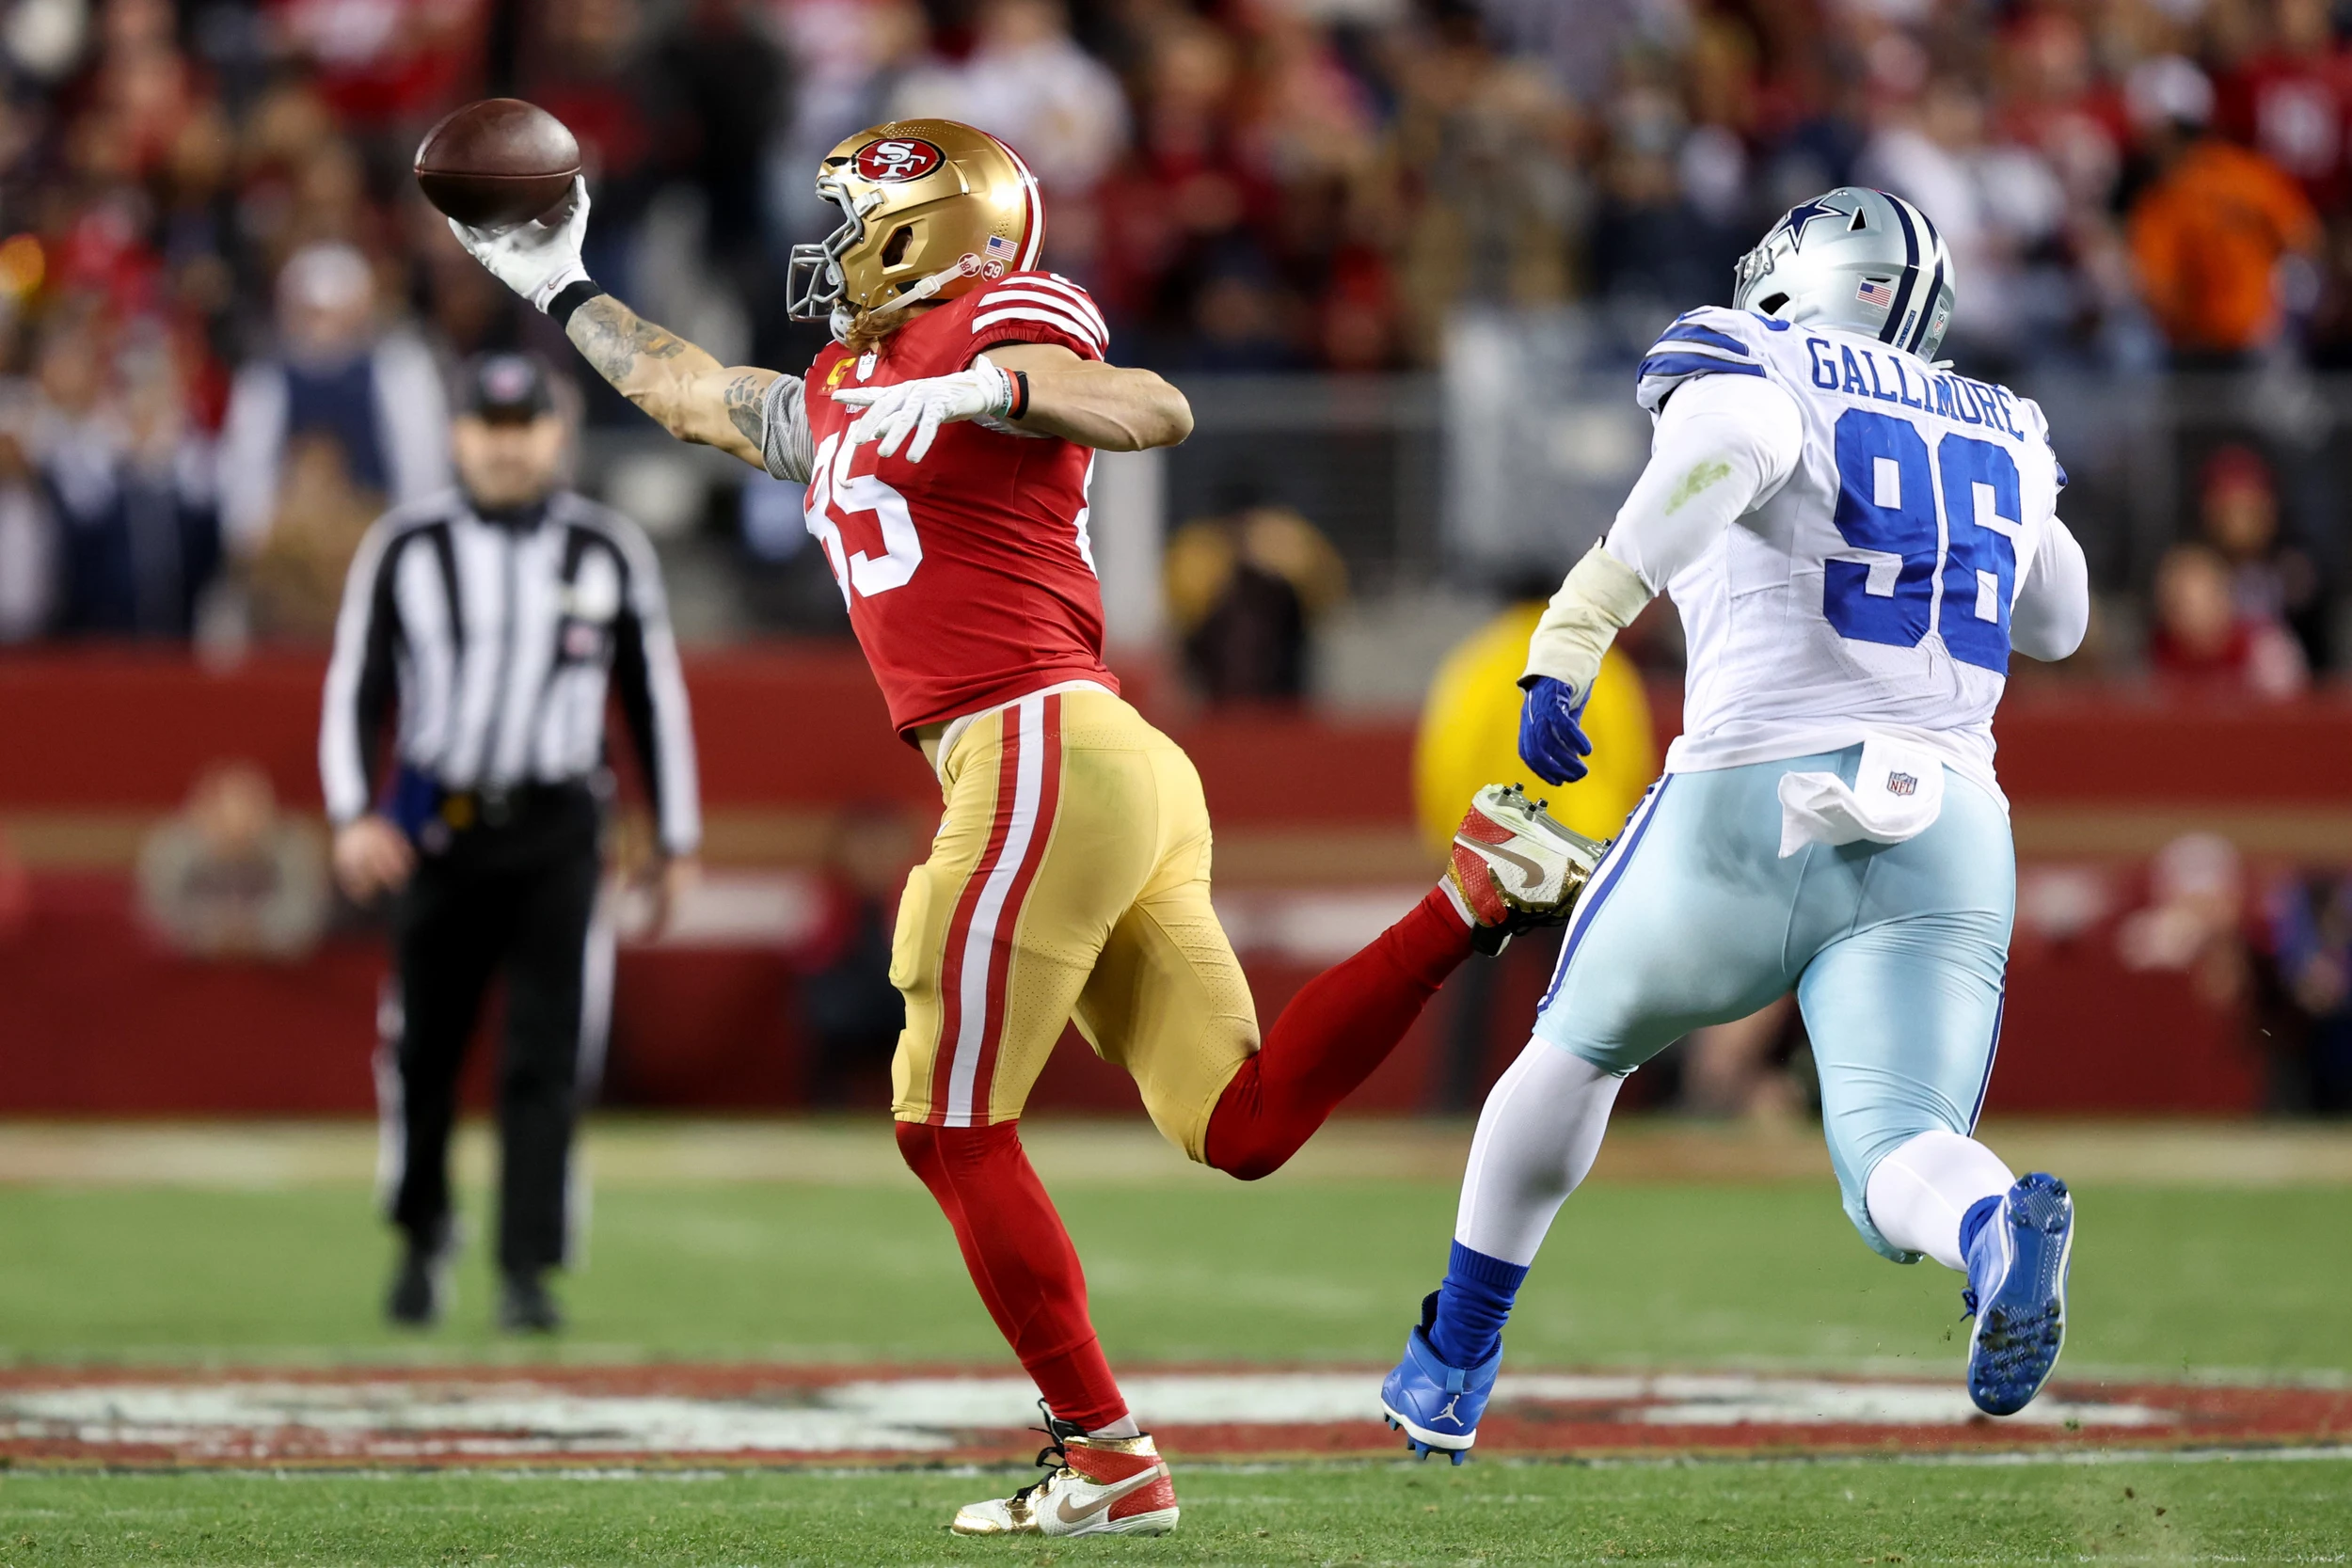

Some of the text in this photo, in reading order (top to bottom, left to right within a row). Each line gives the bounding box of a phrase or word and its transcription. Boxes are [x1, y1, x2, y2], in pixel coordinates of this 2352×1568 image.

[960, 261, 972, 272] 85
[984, 262, 1002, 279] 39
[827, 356, 857, 386] C
[1805, 337, 2025, 442] GALLIMORE
[1822, 406, 2022, 677] 96
[1890, 779, 1912, 794] NFL
